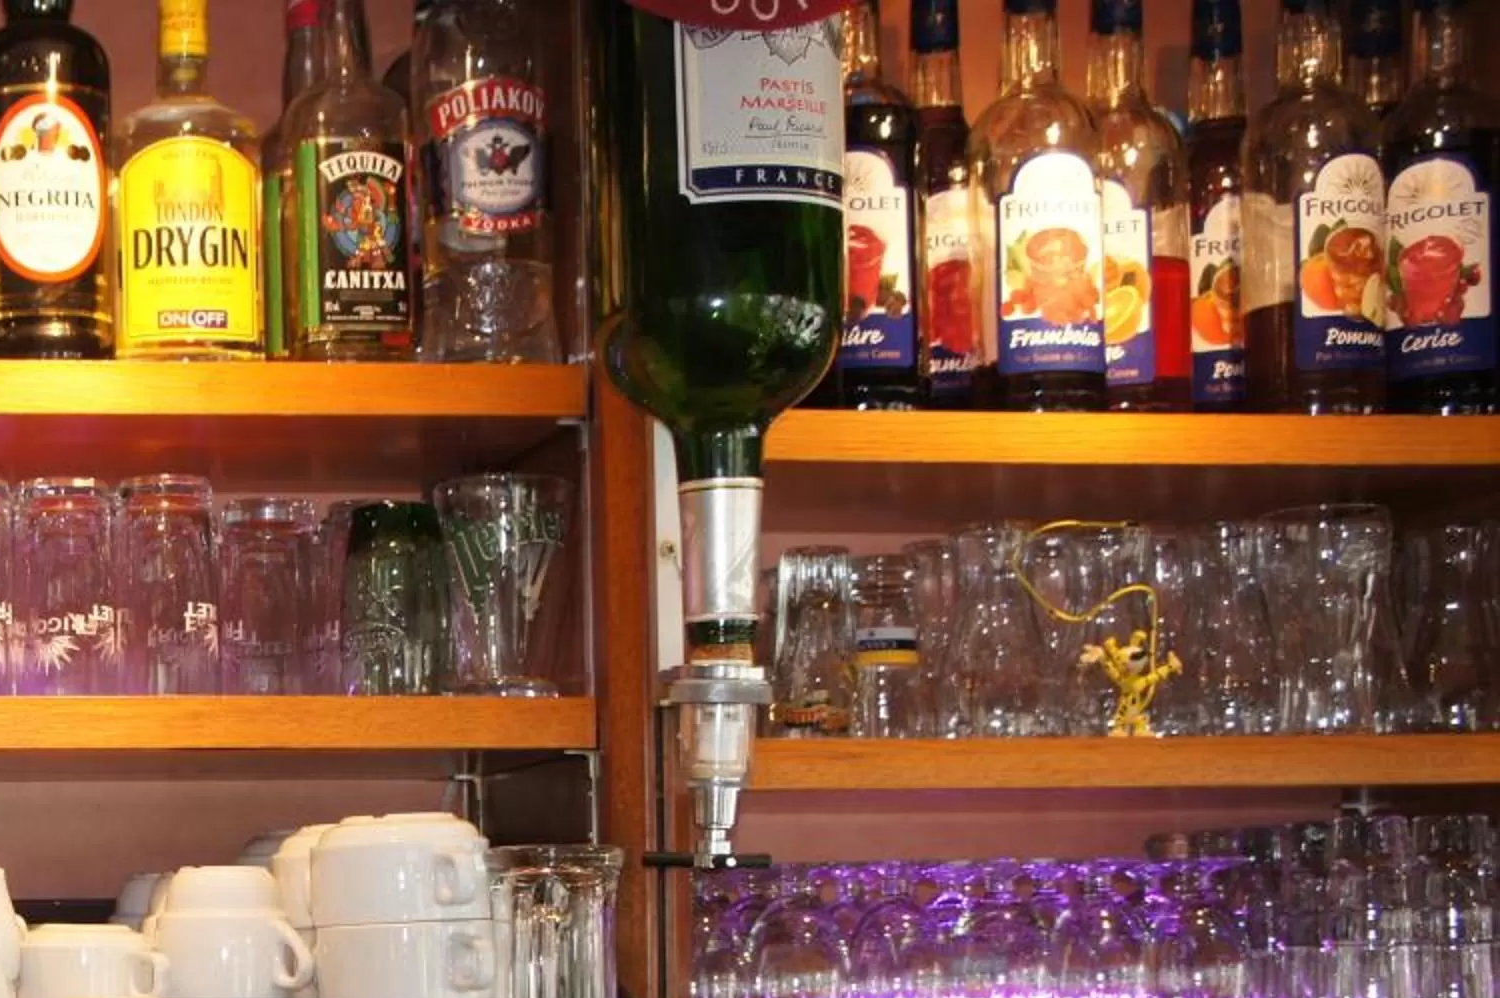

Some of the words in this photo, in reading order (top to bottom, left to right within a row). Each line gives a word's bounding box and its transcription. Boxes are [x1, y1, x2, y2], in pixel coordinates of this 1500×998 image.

[760, 76, 816, 95] PASTIS
[438, 85, 545, 130] POLIAKOV
[739, 95, 828, 115] MARSEILLE
[325, 153, 399, 178] TEQUILA
[735, 168, 836, 189] FRANCE
[156, 200, 224, 224] LONDON
[469, 215, 533, 233] VODKA
[133, 226, 195, 270] DRY
[199, 225, 249, 270] GIN
[324, 269, 406, 290] CANITXA
[1401, 327, 1463, 353] Cerise
